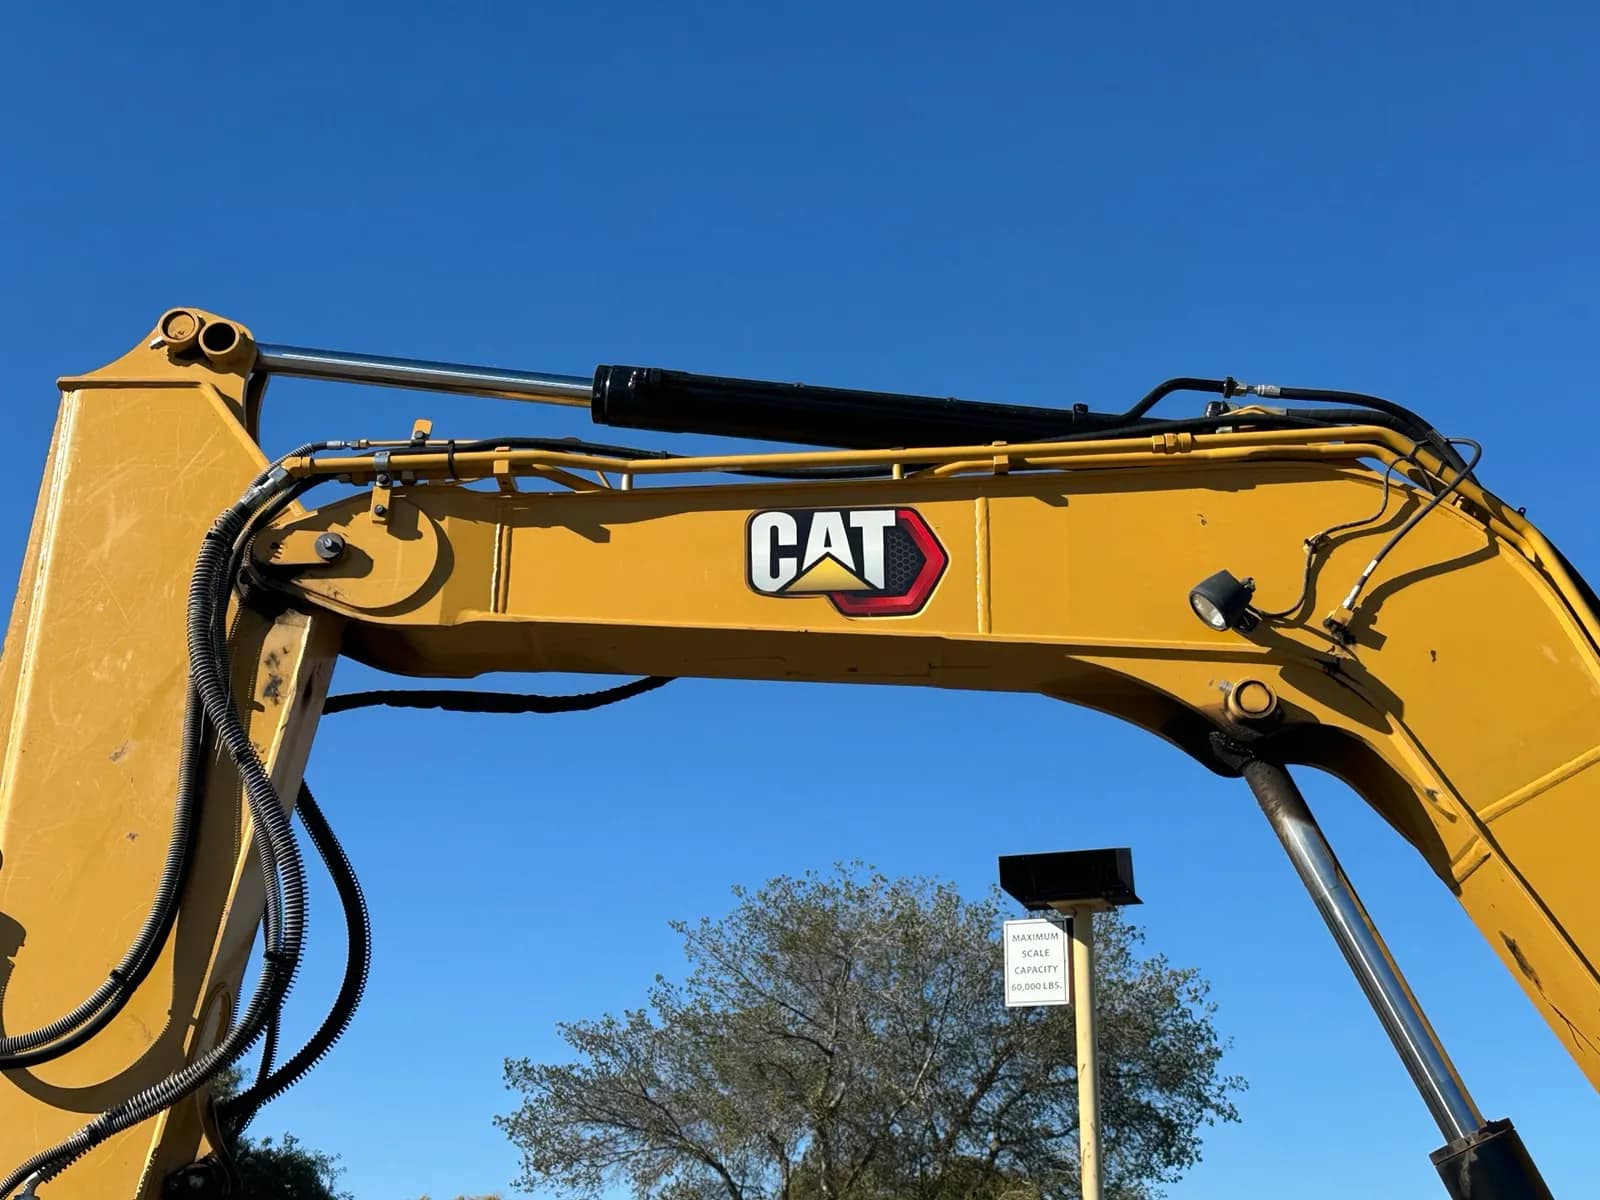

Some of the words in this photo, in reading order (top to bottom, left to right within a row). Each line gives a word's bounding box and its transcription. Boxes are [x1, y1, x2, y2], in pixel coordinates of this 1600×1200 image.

[751, 510, 896, 592] CAT
[1012, 932, 1059, 942] MAXIMUM
[1022, 949, 1050, 958] SCALE
[1014, 965, 1058, 975] CAPACITY
[1011, 983, 1041, 991] 60,000
[1043, 981, 1063, 990] LBS.
